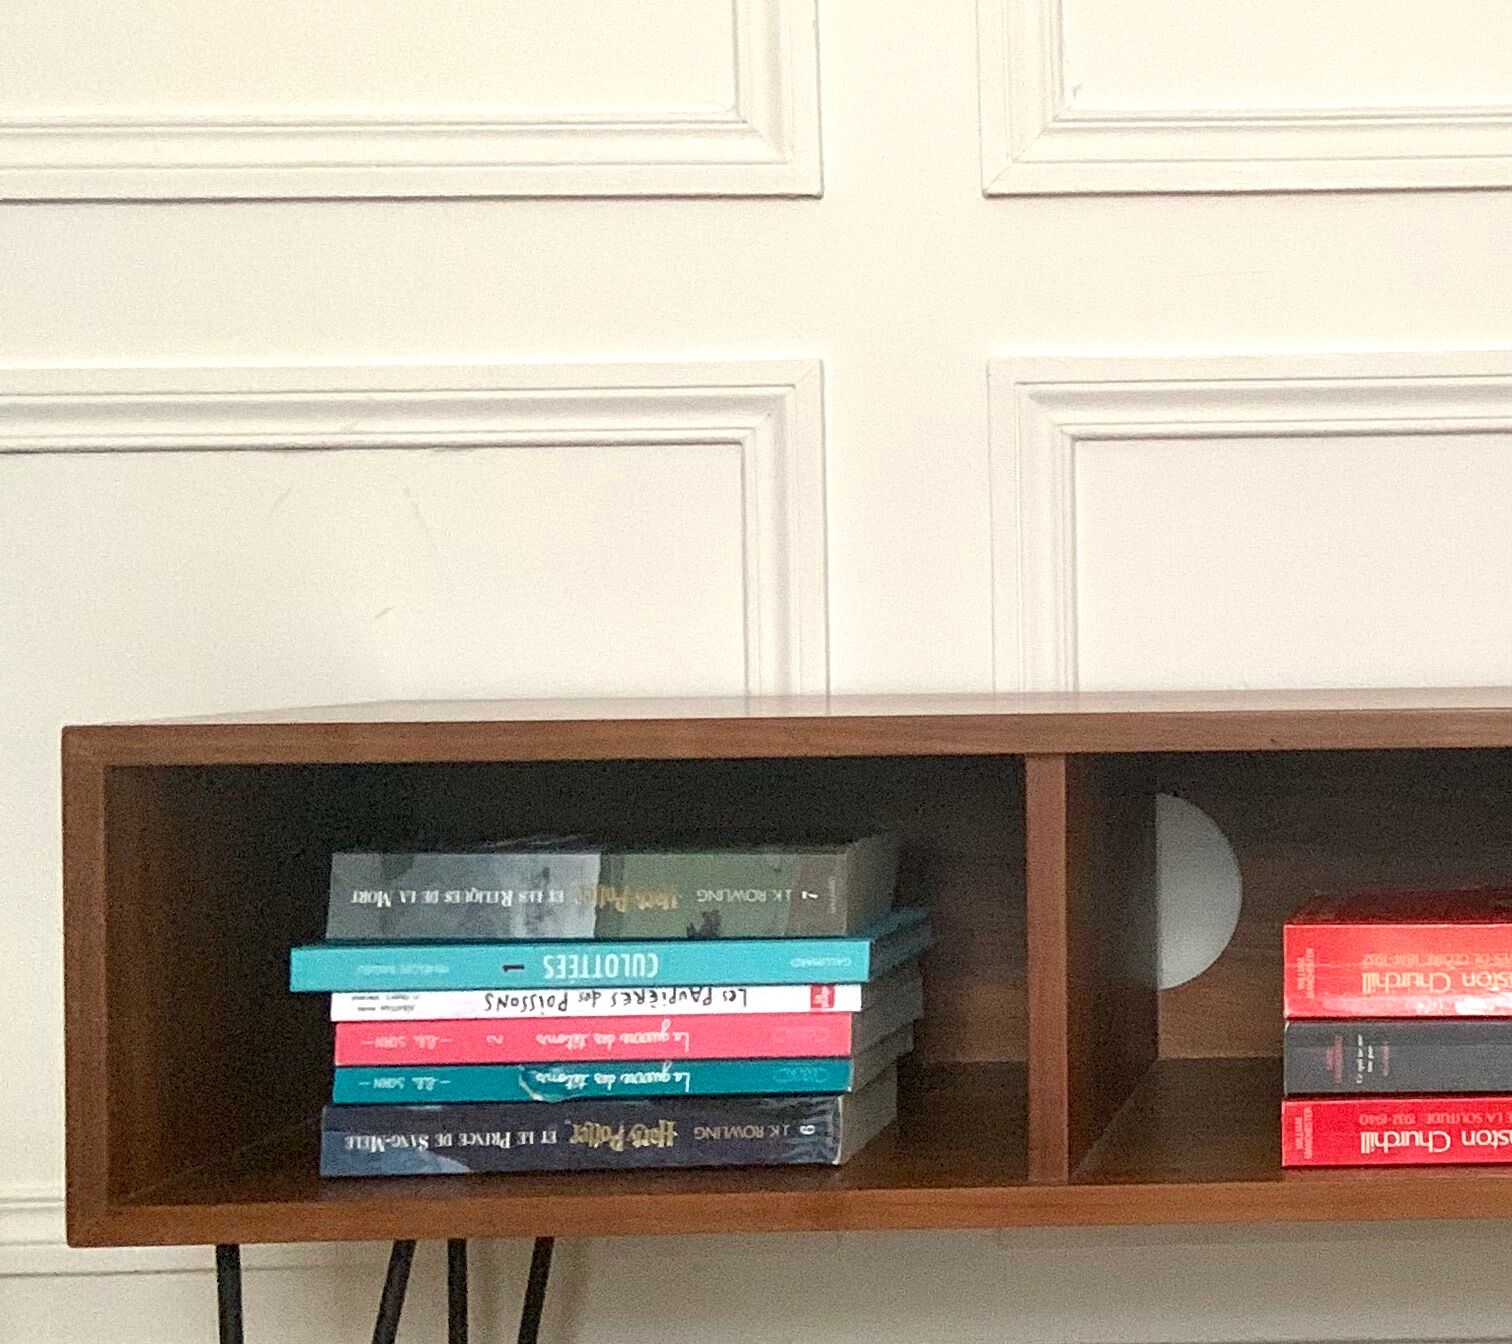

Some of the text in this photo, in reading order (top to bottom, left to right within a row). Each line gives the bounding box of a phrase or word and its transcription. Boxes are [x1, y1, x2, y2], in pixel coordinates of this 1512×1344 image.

[351, 890, 392, 908] MORT
[399, 890, 416, 904] LA
[422, 890, 439, 905] DE
[444, 888, 514, 908] RELIQUES
[547, 889, 565, 903] ET
[696, 889, 767, 903] ROWLING
[802, 890, 818, 899] 7
[542, 952, 659, 985] CULOTTÉES
[1361, 971, 1451, 993] Churchill
[578, 990, 601, 1008] des
[722, 988, 747, 1008] Les
[619, 1019, 670, 1045] guerre
[592, 1033, 615, 1050] des
[593, 1073, 616, 1090] des
[619, 1061, 672, 1086] guerre
[1486, 1111, 1503, 1125] LA
[434, 1134, 453, 1147] DE
[458, 1131, 512, 1149] PRINCE
[517, 1131, 534, 1145] LE
[541, 1130, 557, 1144] ET
[569, 1121, 624, 1152] Potter
[626, 1119, 678, 1148] Harry
[693, 1124, 765, 1140] ROWLING
[1361, 1130, 1452, 1154] Churchill
